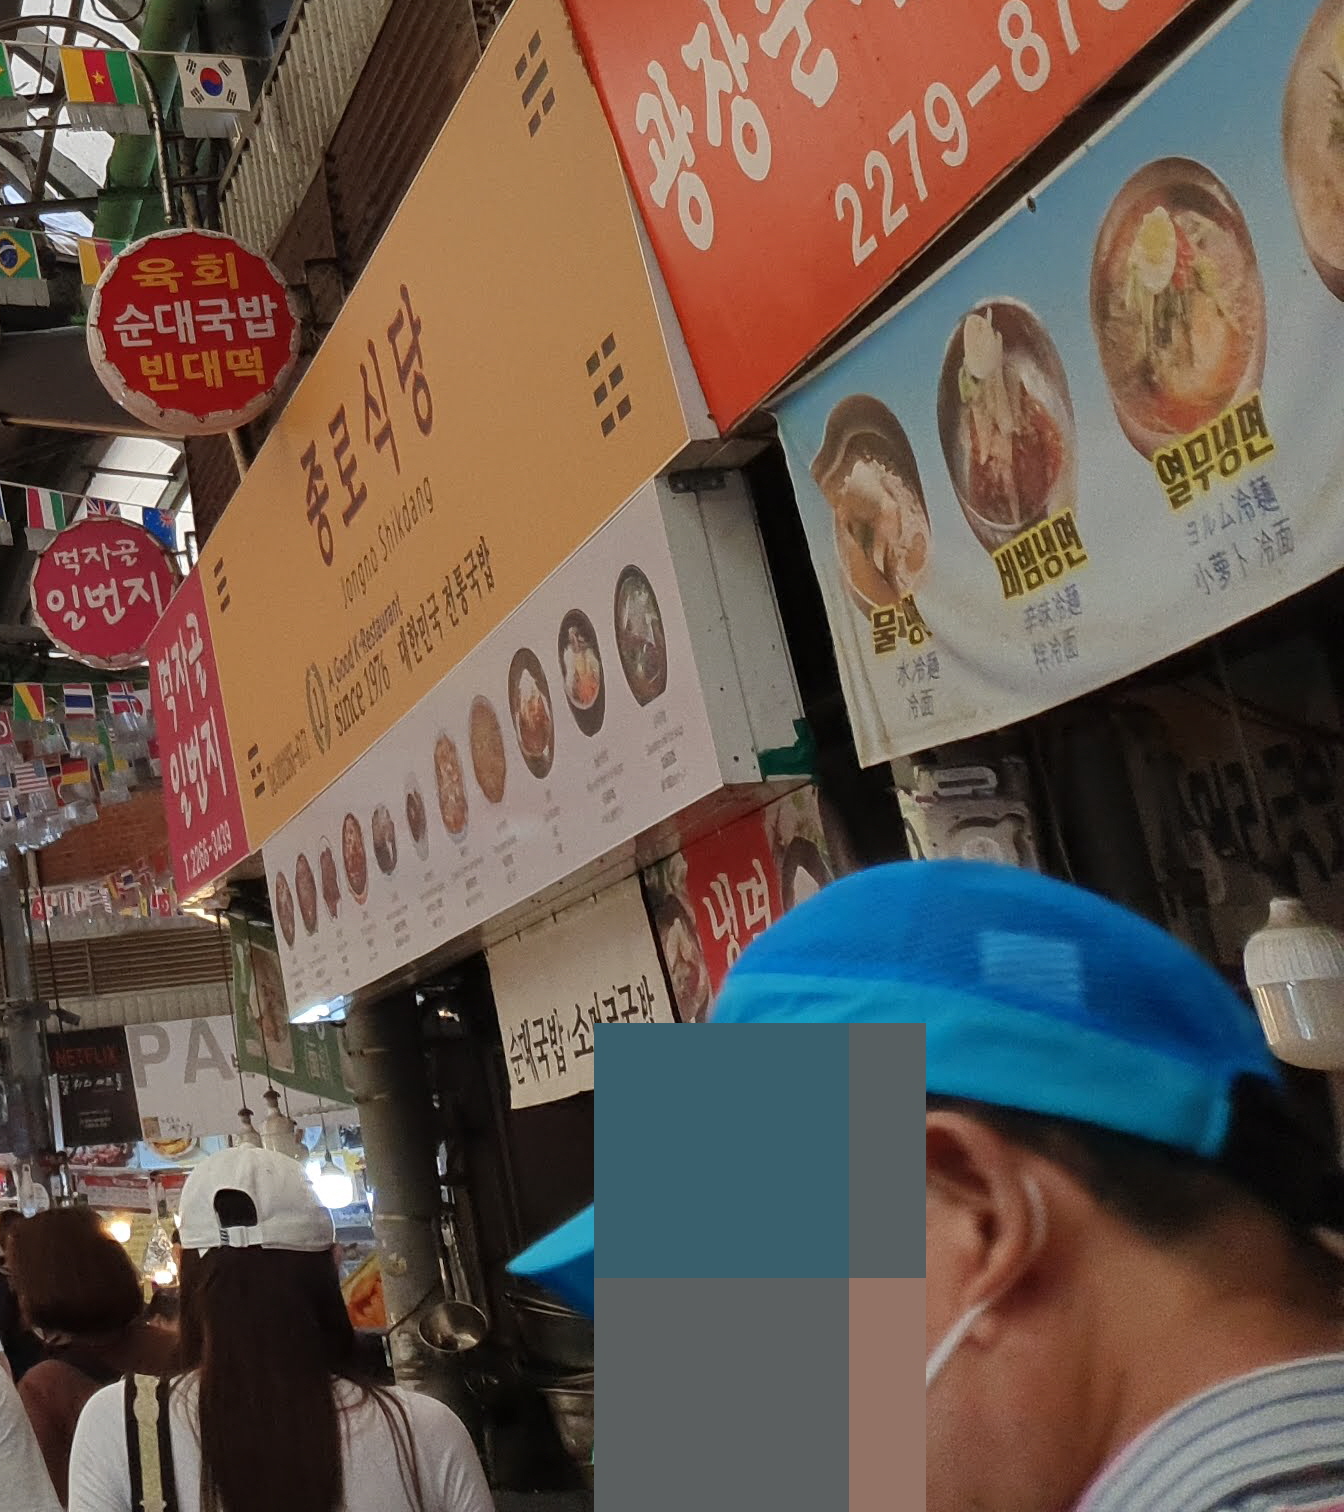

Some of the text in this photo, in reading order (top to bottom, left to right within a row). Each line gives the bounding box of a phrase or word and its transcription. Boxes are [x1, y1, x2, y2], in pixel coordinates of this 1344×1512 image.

[113, 294, 278, 348] 순대국밥
[139, 346, 266, 391] 빈대떡
[300, 283, 433, 568] 종로식당
[1155, 394, 1275, 511] 열무냉면
[53, 539, 140, 576] 먹자골
[339, 476, 434, 611] Jongno Shikdang
[993, 509, 1089, 601] 비빔냉면
[46, 571, 163, 632] 일번지
[396, 592, 444, 674] 대한민국
[333, 648, 392, 738] since 1976
[169, 705, 228, 830] 일번지
[124, 1018, 239, 1089] PA
